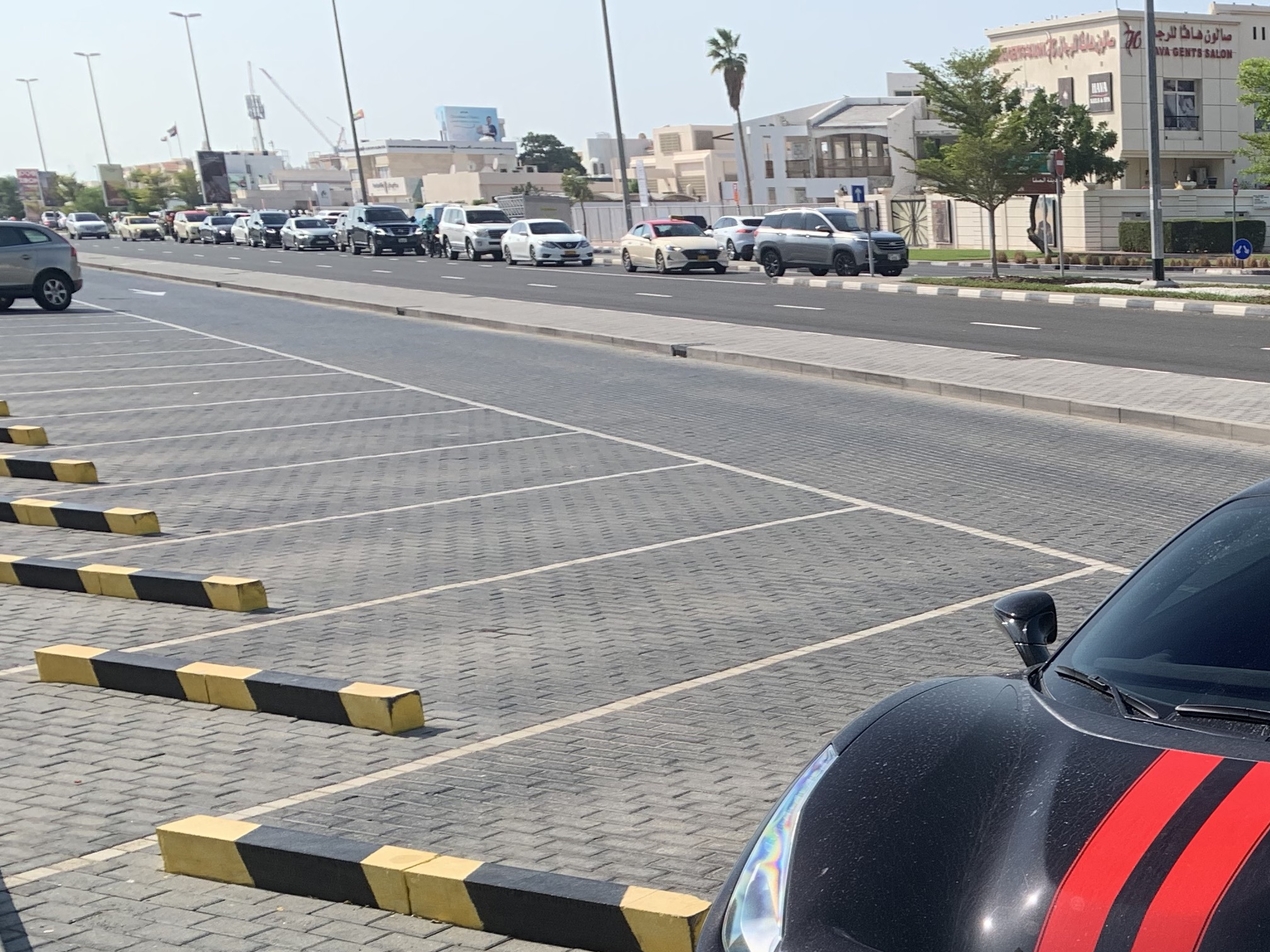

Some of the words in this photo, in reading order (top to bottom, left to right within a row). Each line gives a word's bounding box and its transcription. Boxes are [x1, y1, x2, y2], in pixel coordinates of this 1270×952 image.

[1204, 27, 1232, 45] صالون
[1173, 47, 1202, 58] GENTS
[1204, 49, 1233, 59] SALON
